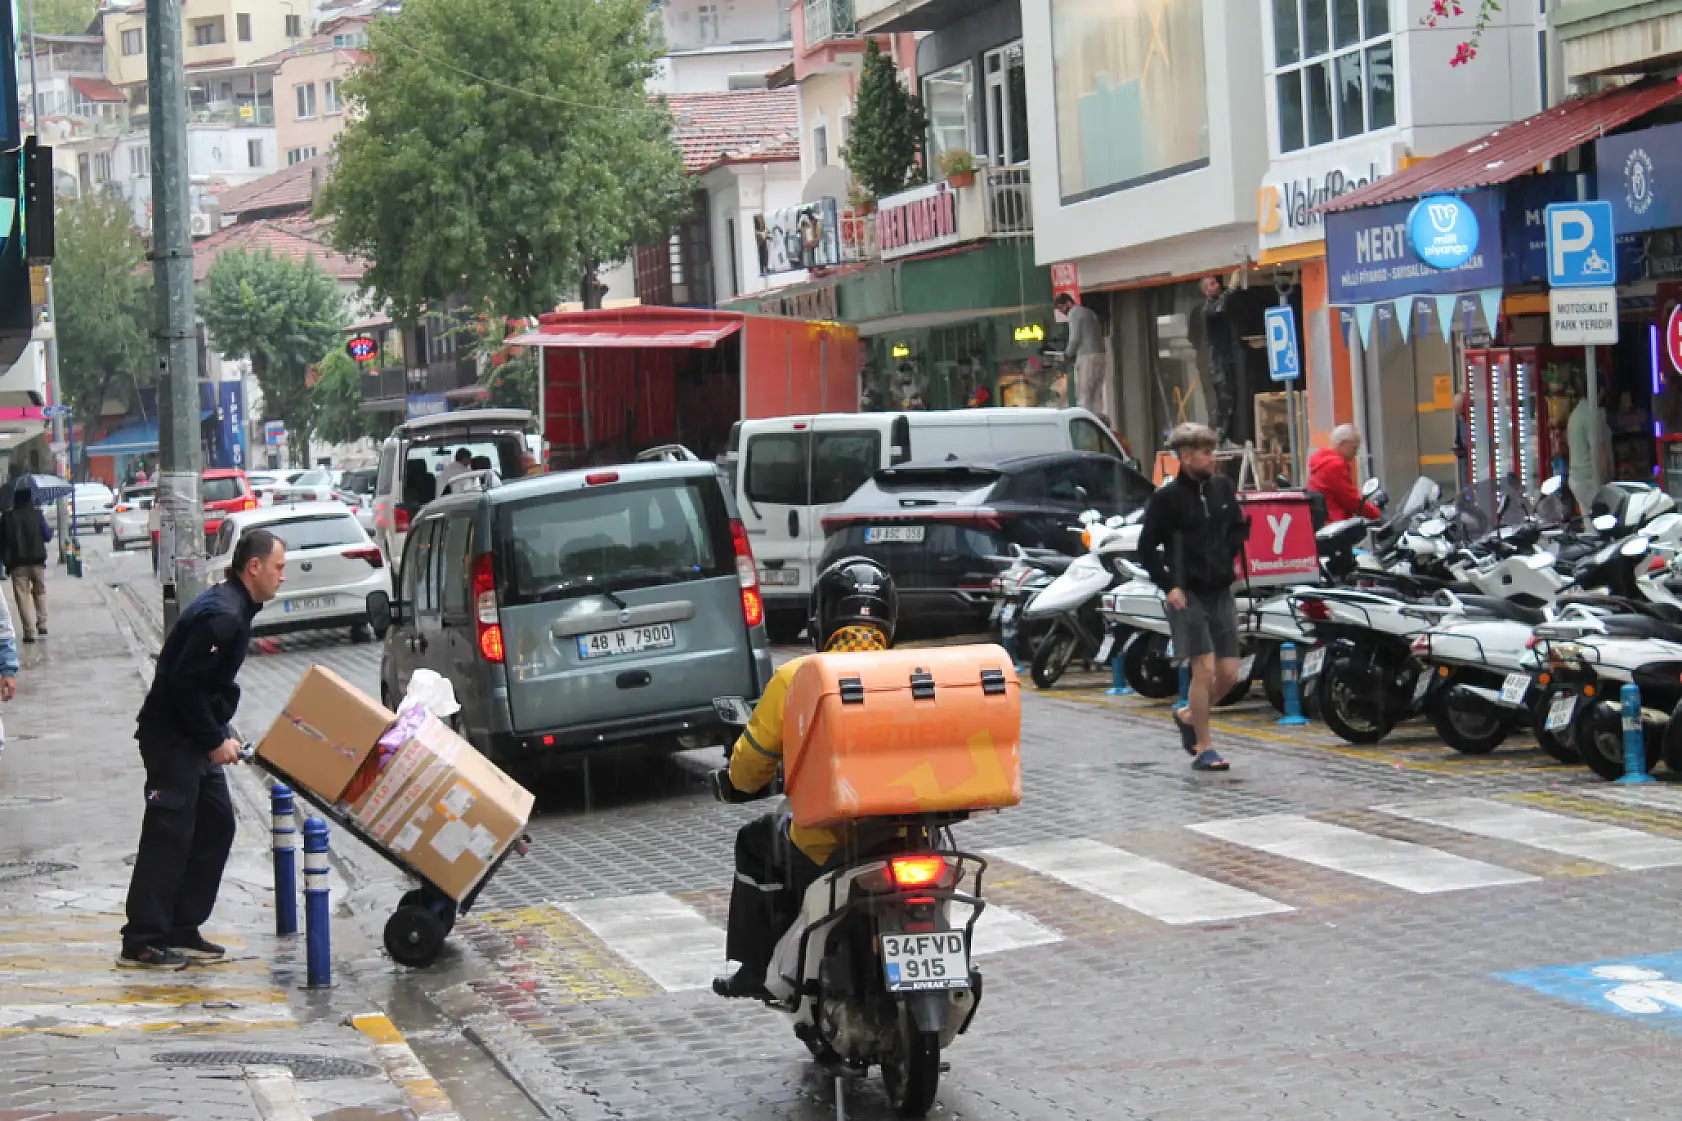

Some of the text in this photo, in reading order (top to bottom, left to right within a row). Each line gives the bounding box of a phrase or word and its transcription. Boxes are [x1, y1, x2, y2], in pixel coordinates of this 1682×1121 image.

[1356, 224, 1405, 264] MERT
[1551, 210, 1594, 277] P
[1555, 319, 1577, 331] PARK
[1270, 316, 1288, 371] P
[1266, 512, 1292, 554] Y
[591, 625, 670, 650] 48 H 7900
[886, 935, 962, 957] 34FVD
[906, 958, 946, 978] 915
